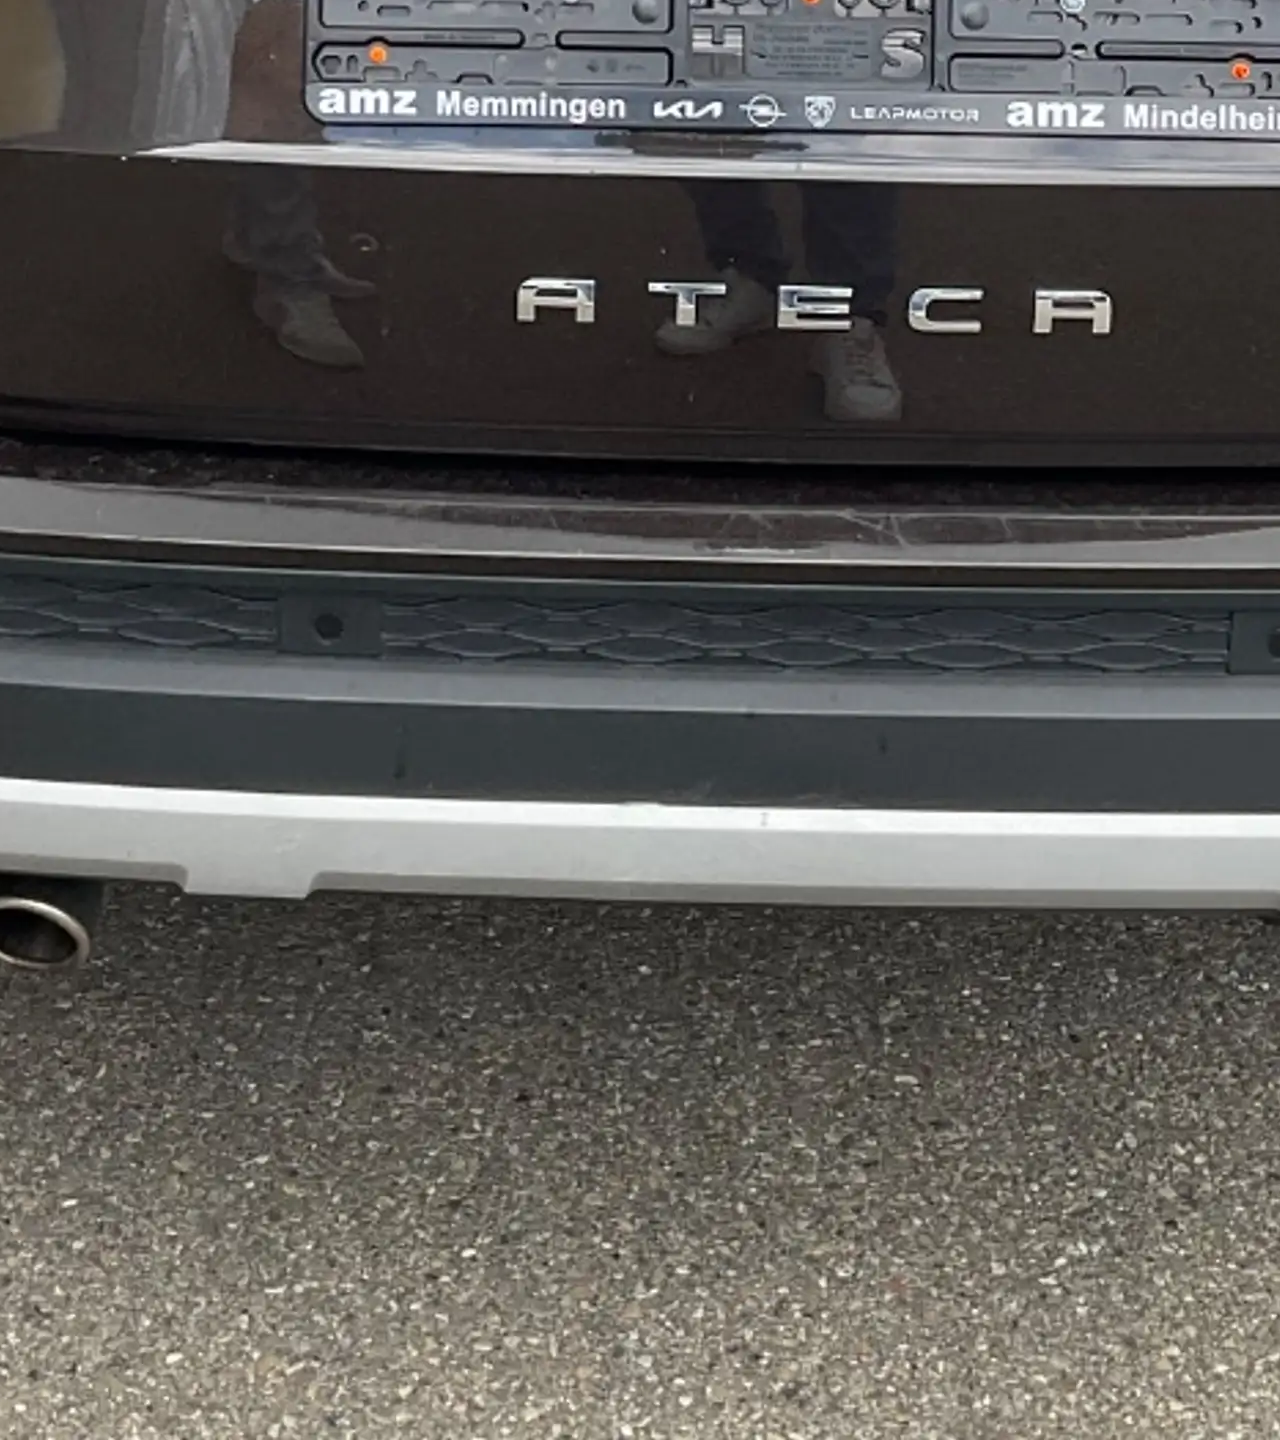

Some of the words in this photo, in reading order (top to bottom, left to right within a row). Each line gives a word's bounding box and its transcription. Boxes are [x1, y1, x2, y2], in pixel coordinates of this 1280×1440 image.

[319, 88, 417, 114] amz
[436, 90, 626, 123] Memmingen
[850, 107, 979, 122] LEAPMOTOR
[1006, 101, 1105, 128] amz
[517, 277, 1112, 334] ATECA
